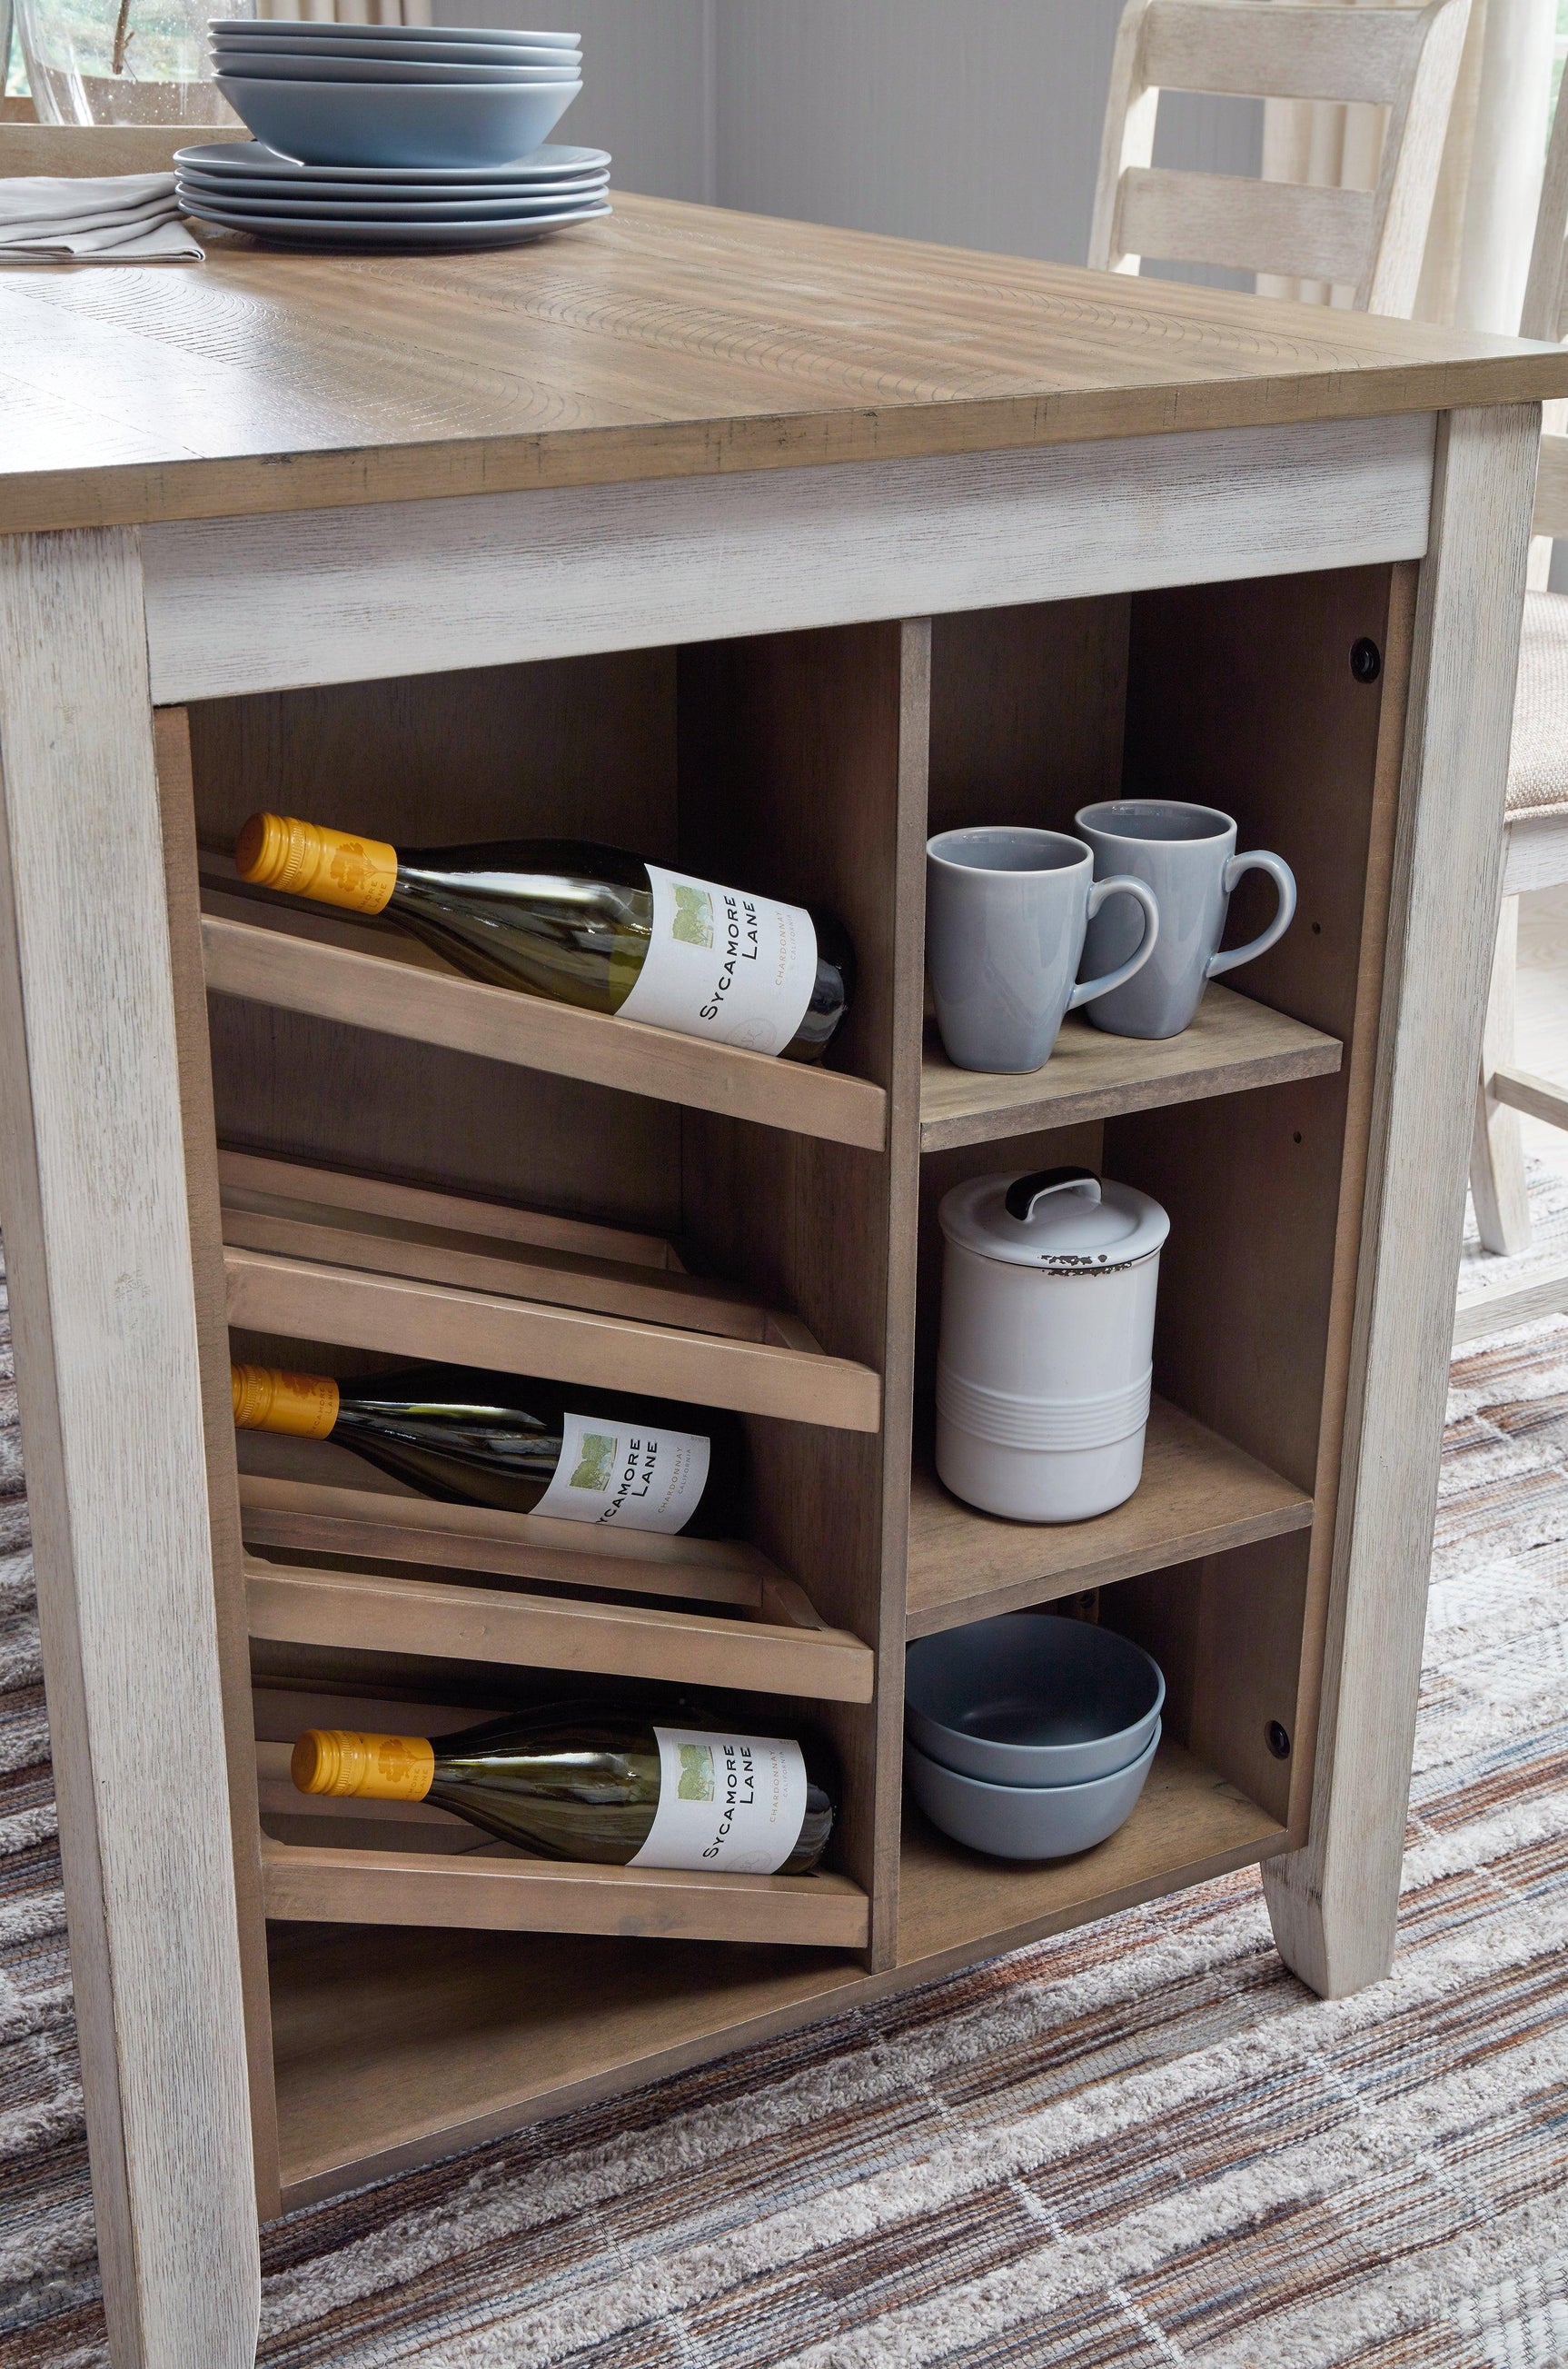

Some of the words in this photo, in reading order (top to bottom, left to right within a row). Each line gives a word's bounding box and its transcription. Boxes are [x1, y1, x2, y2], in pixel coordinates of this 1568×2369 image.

[700, 894, 739, 1020] SYCAMORE
[741, 900, 759, 961] LANE
[775, 911, 788, 986] CHARDONNAY
[595, 1438, 641, 1524] YCAMORE
[631, 1441, 658, 1498] LANE
[657, 1447, 683, 1514] CHARDONNAY
[677, 1448, 692, 1495] CALIFORNIA
[702, 1744, 738, 1859] SYCAMORE
[739, 1746, 755, 1806] LANE
[769, 1750, 780, 1823] CHARDONNAY
[780, 1750, 789, 1798] CALIFORNIA
